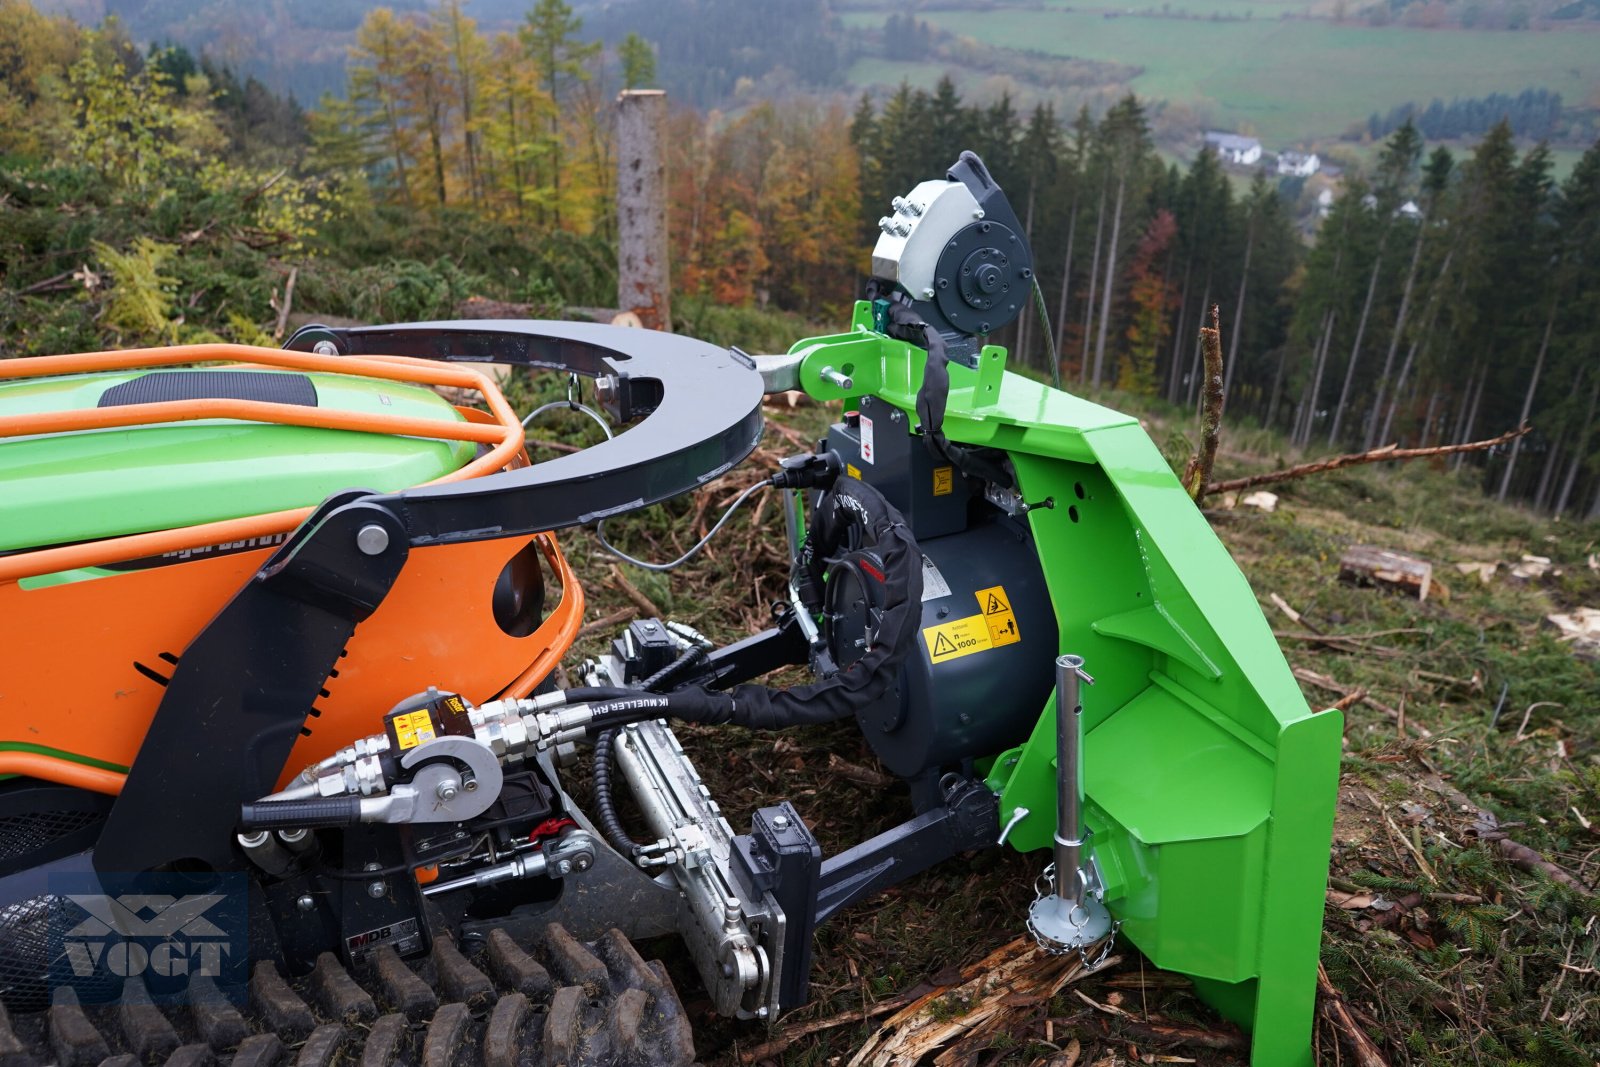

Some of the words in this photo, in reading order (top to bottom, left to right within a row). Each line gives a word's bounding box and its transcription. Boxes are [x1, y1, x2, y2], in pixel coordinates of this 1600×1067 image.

[957, 638, 977, 648] 1000
[611, 699, 657, 711] MUELLER
[350, 927, 391, 948] MDB
